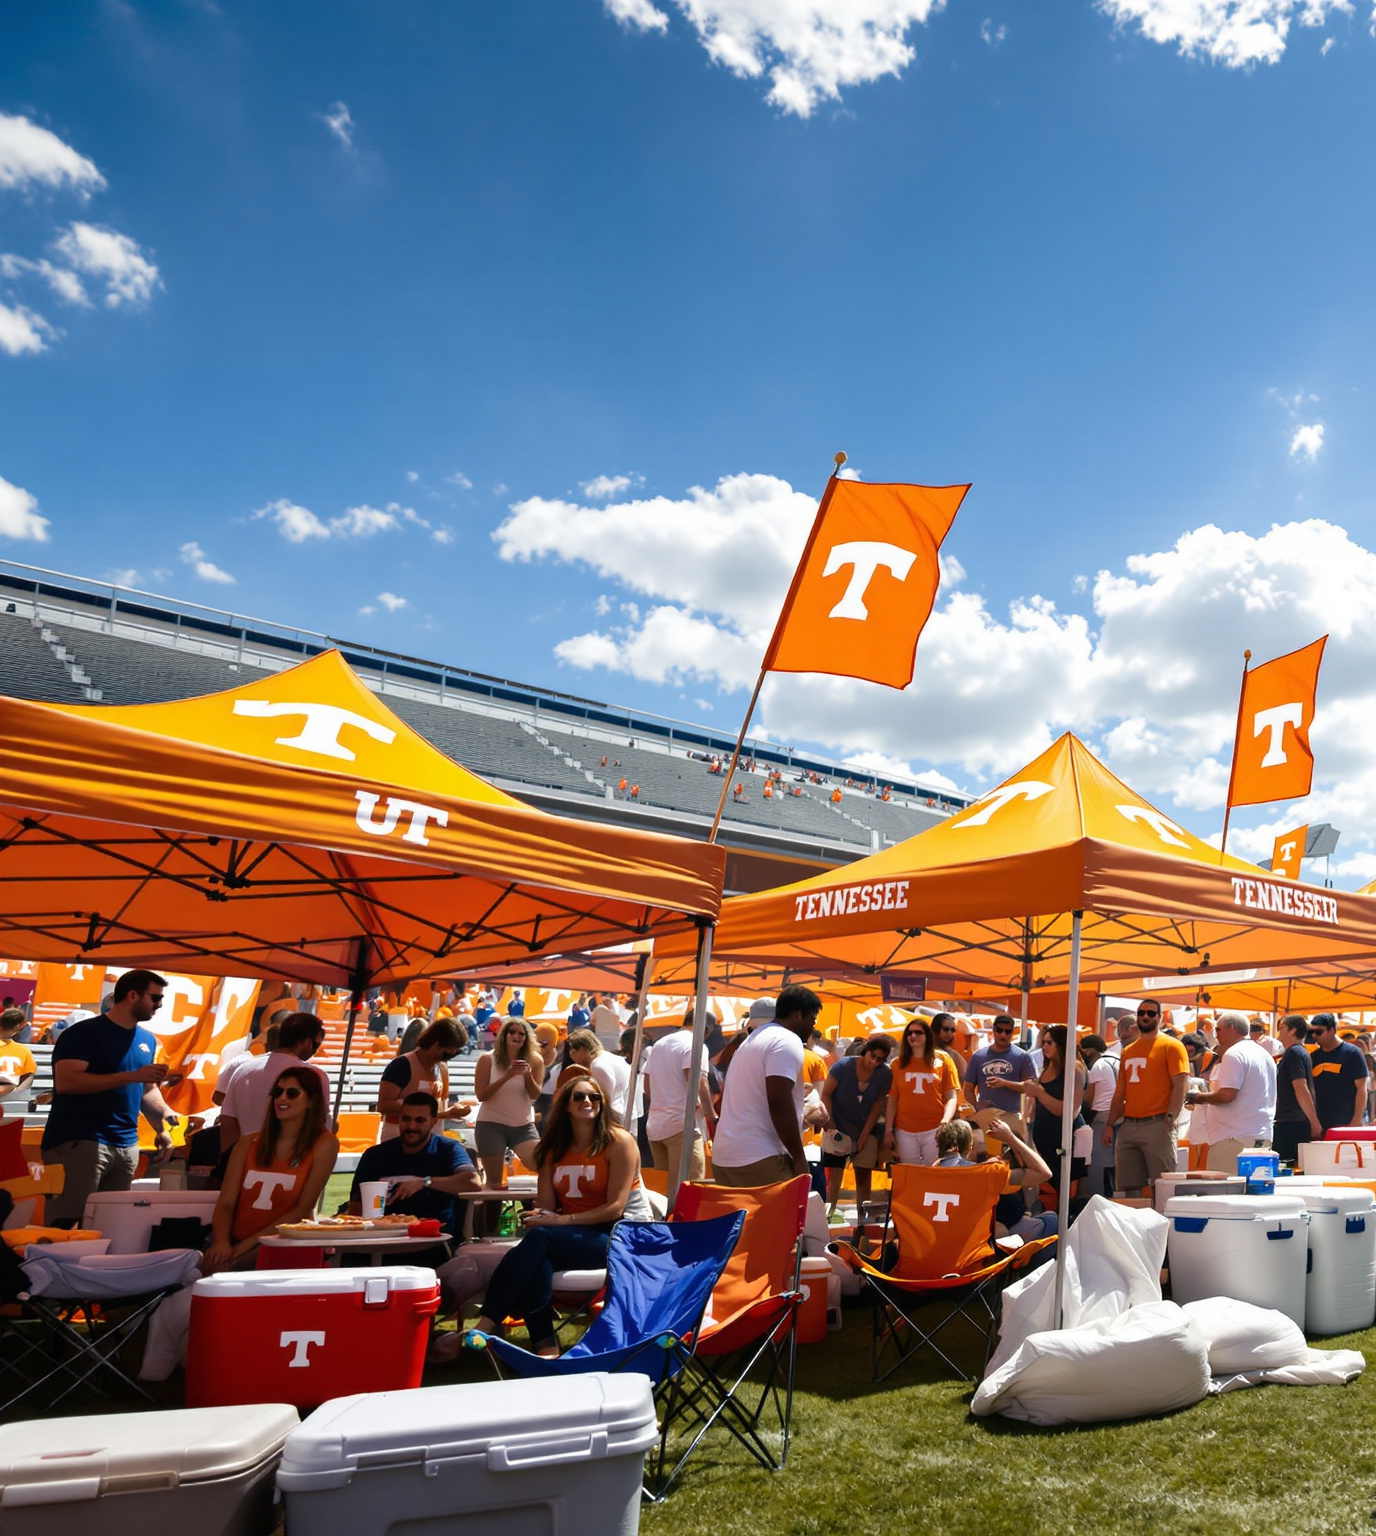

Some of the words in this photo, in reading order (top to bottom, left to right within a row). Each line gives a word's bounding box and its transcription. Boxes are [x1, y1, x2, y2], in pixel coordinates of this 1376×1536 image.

[822, 541, 917, 621] T
[233, 699, 396, 762] T
[1253, 702, 1303, 768] T
[355, 790, 449, 846] UT
[1280, 841, 1296, 862] T
[795, 881, 910, 922] TENNESSEE
[183, 1053, 220, 1080] T
[904, 1072, 938, 1094] T
[1124, 1057, 1147, 1083] T
[243, 1170, 297, 1210] T
[553, 1165, 596, 1198] T
[923, 1192, 960, 1222] T
[280, 1330, 325, 1367] T
